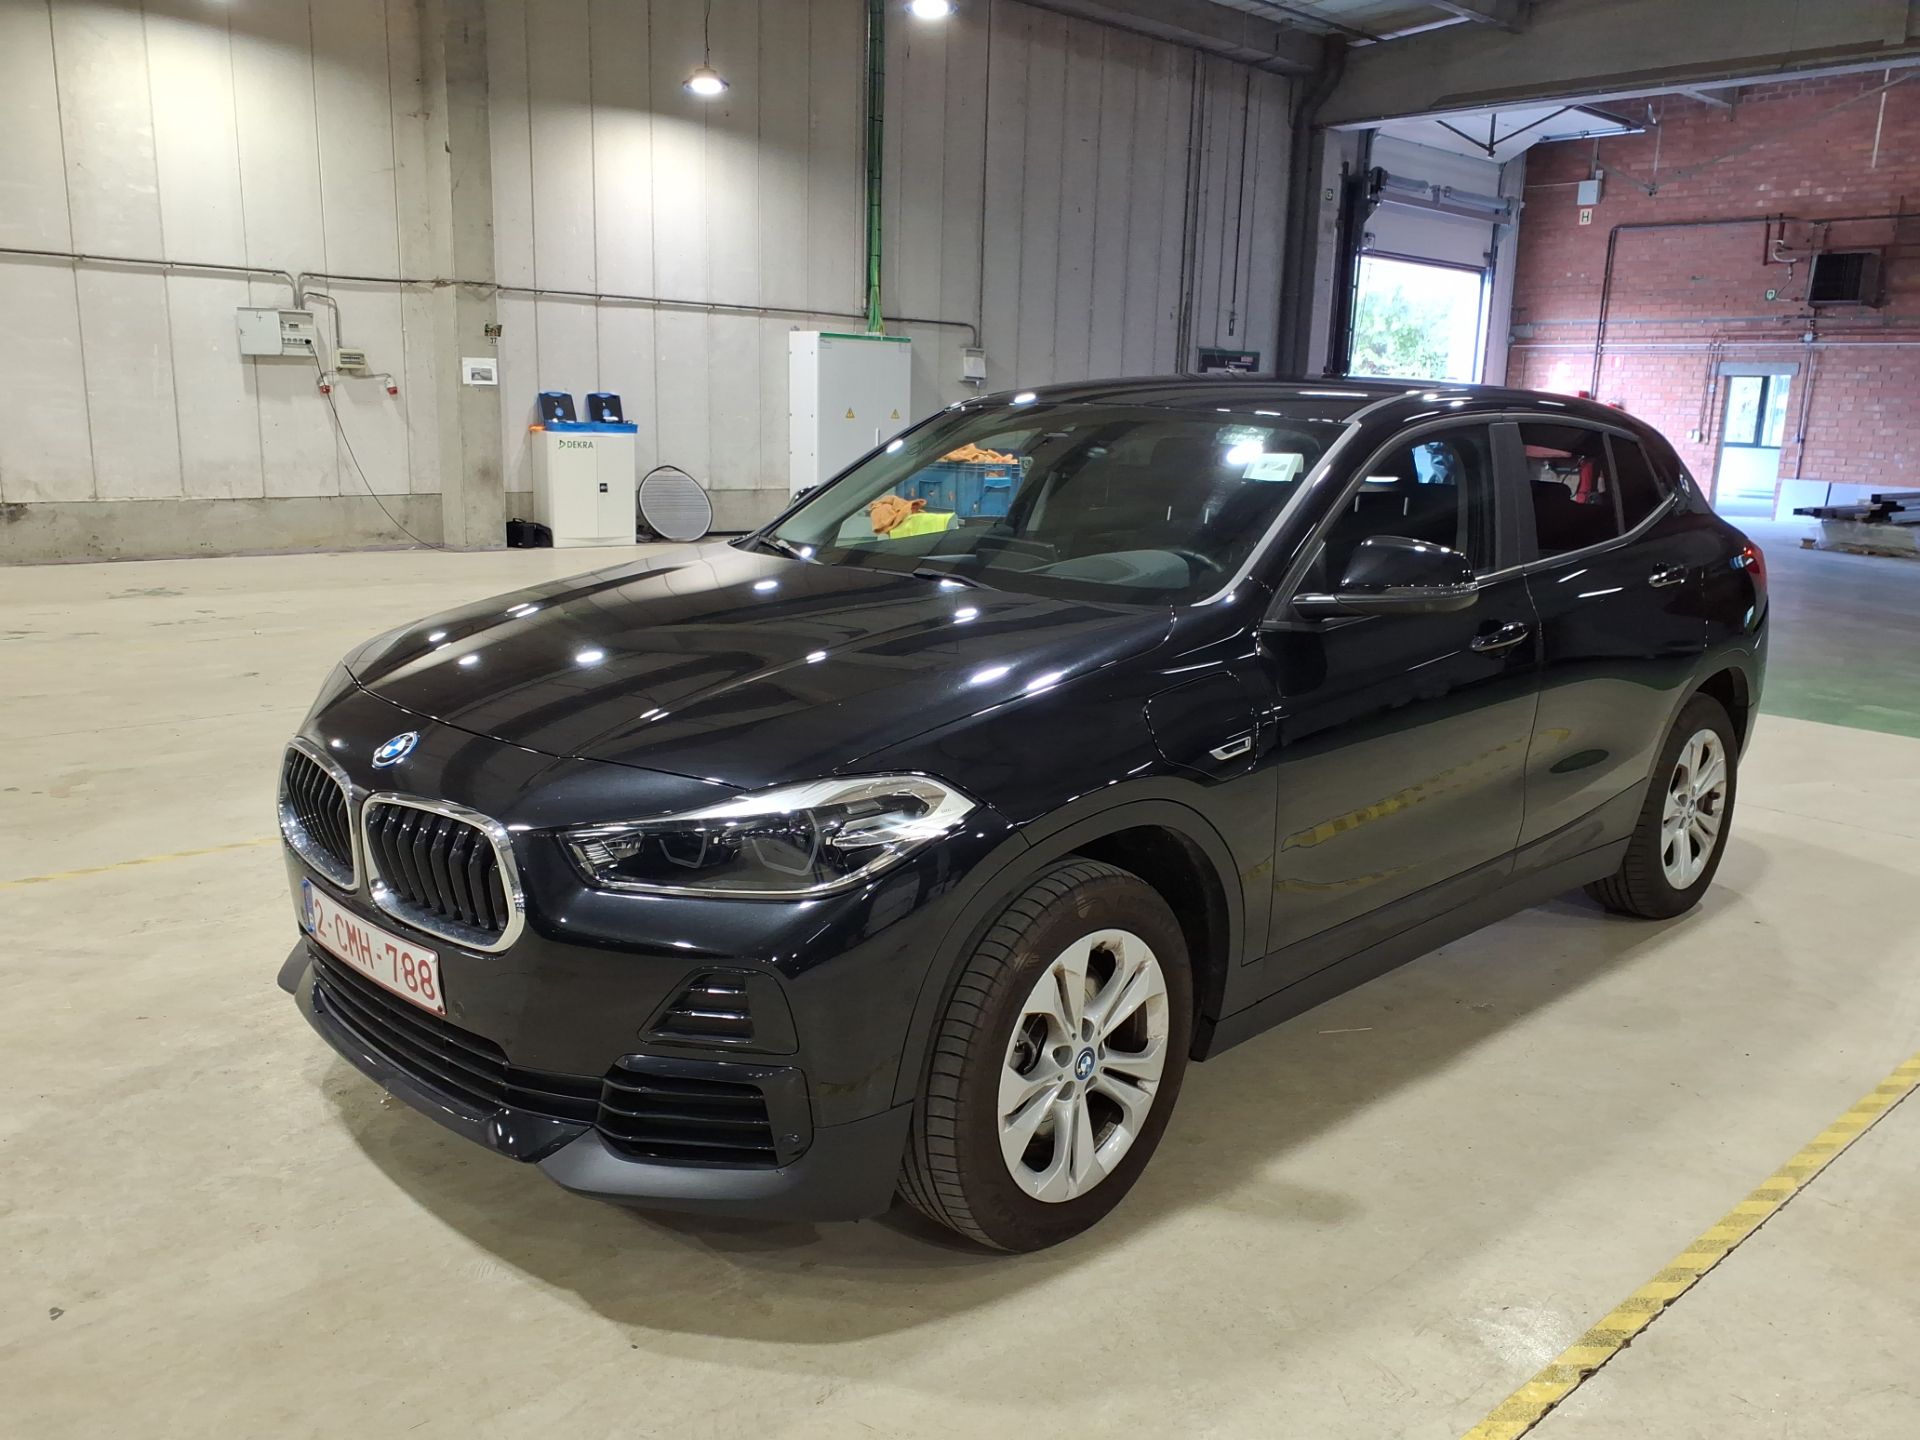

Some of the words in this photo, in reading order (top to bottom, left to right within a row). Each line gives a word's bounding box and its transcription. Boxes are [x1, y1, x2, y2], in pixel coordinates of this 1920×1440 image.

[1581, 211, 1590, 223] H
[566, 440, 594, 449] DEKRA
[315, 899, 436, 1001] 2-CMH-788
